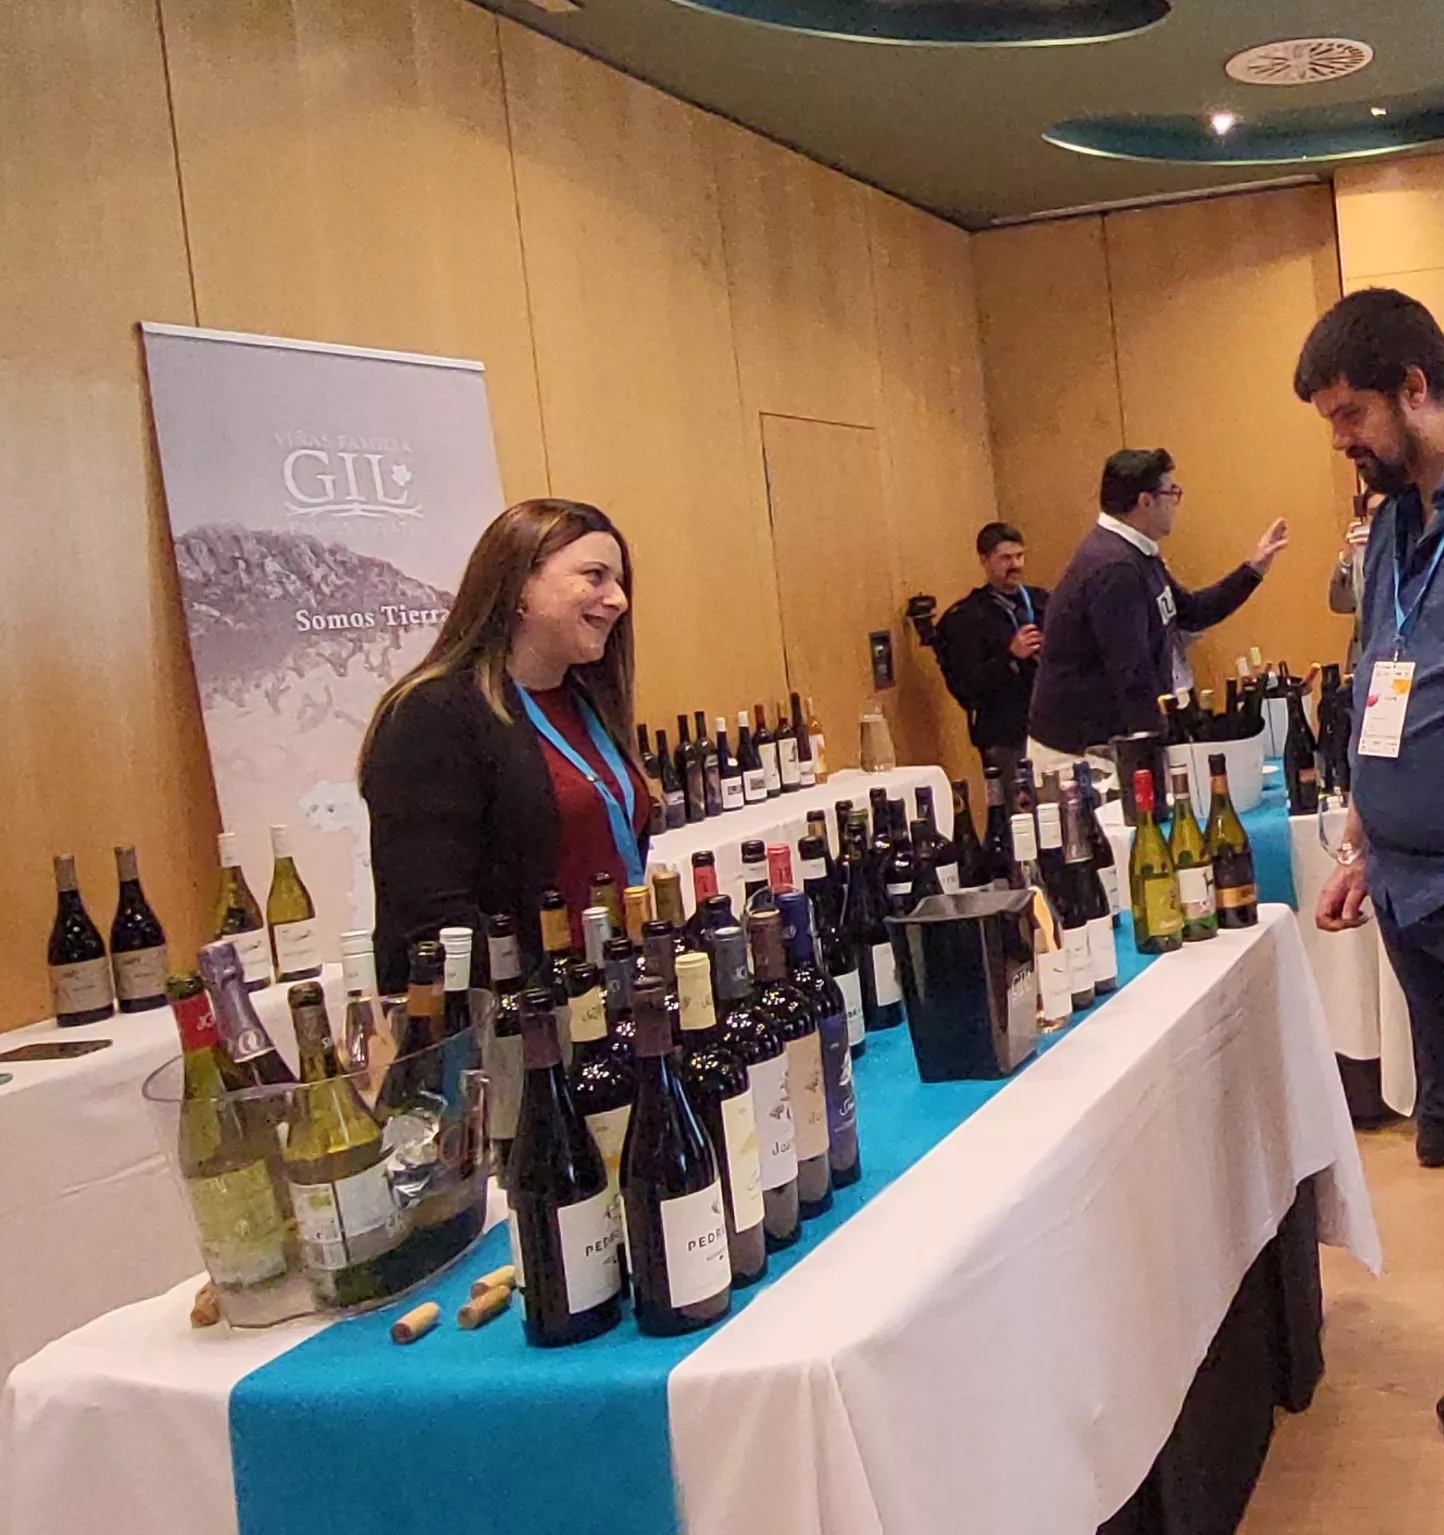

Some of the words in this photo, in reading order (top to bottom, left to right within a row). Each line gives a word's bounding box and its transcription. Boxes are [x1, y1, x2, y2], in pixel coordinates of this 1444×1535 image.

[273, 429, 332, 448] VIÑAS
[283, 448, 410, 505] GIL
[295, 609, 375, 632] Somos
